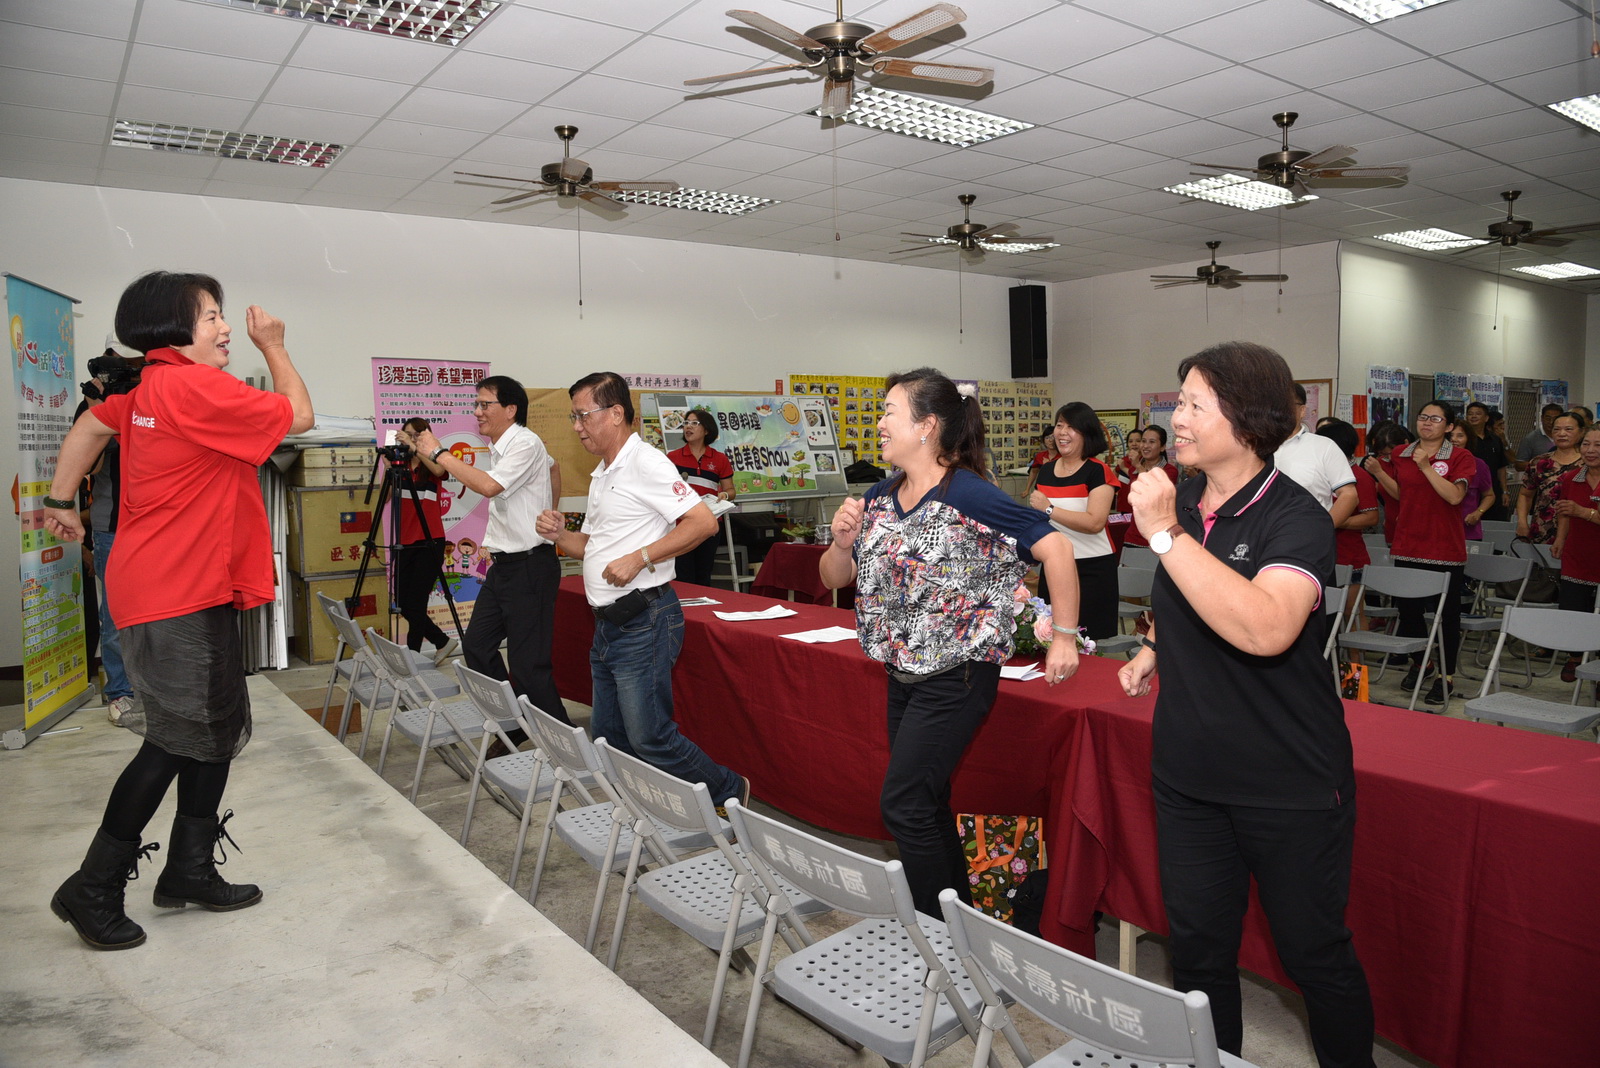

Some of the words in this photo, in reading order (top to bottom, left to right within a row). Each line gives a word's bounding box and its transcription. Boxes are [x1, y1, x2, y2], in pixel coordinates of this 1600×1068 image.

[378, 365, 432, 384] 珍愛生命
[437, 367, 485, 384] 希望無限
[717, 411, 762, 431] 異國料理
[763, 833, 871, 900] 長壽社區
[990, 940, 1148, 1044] 長壽社區
